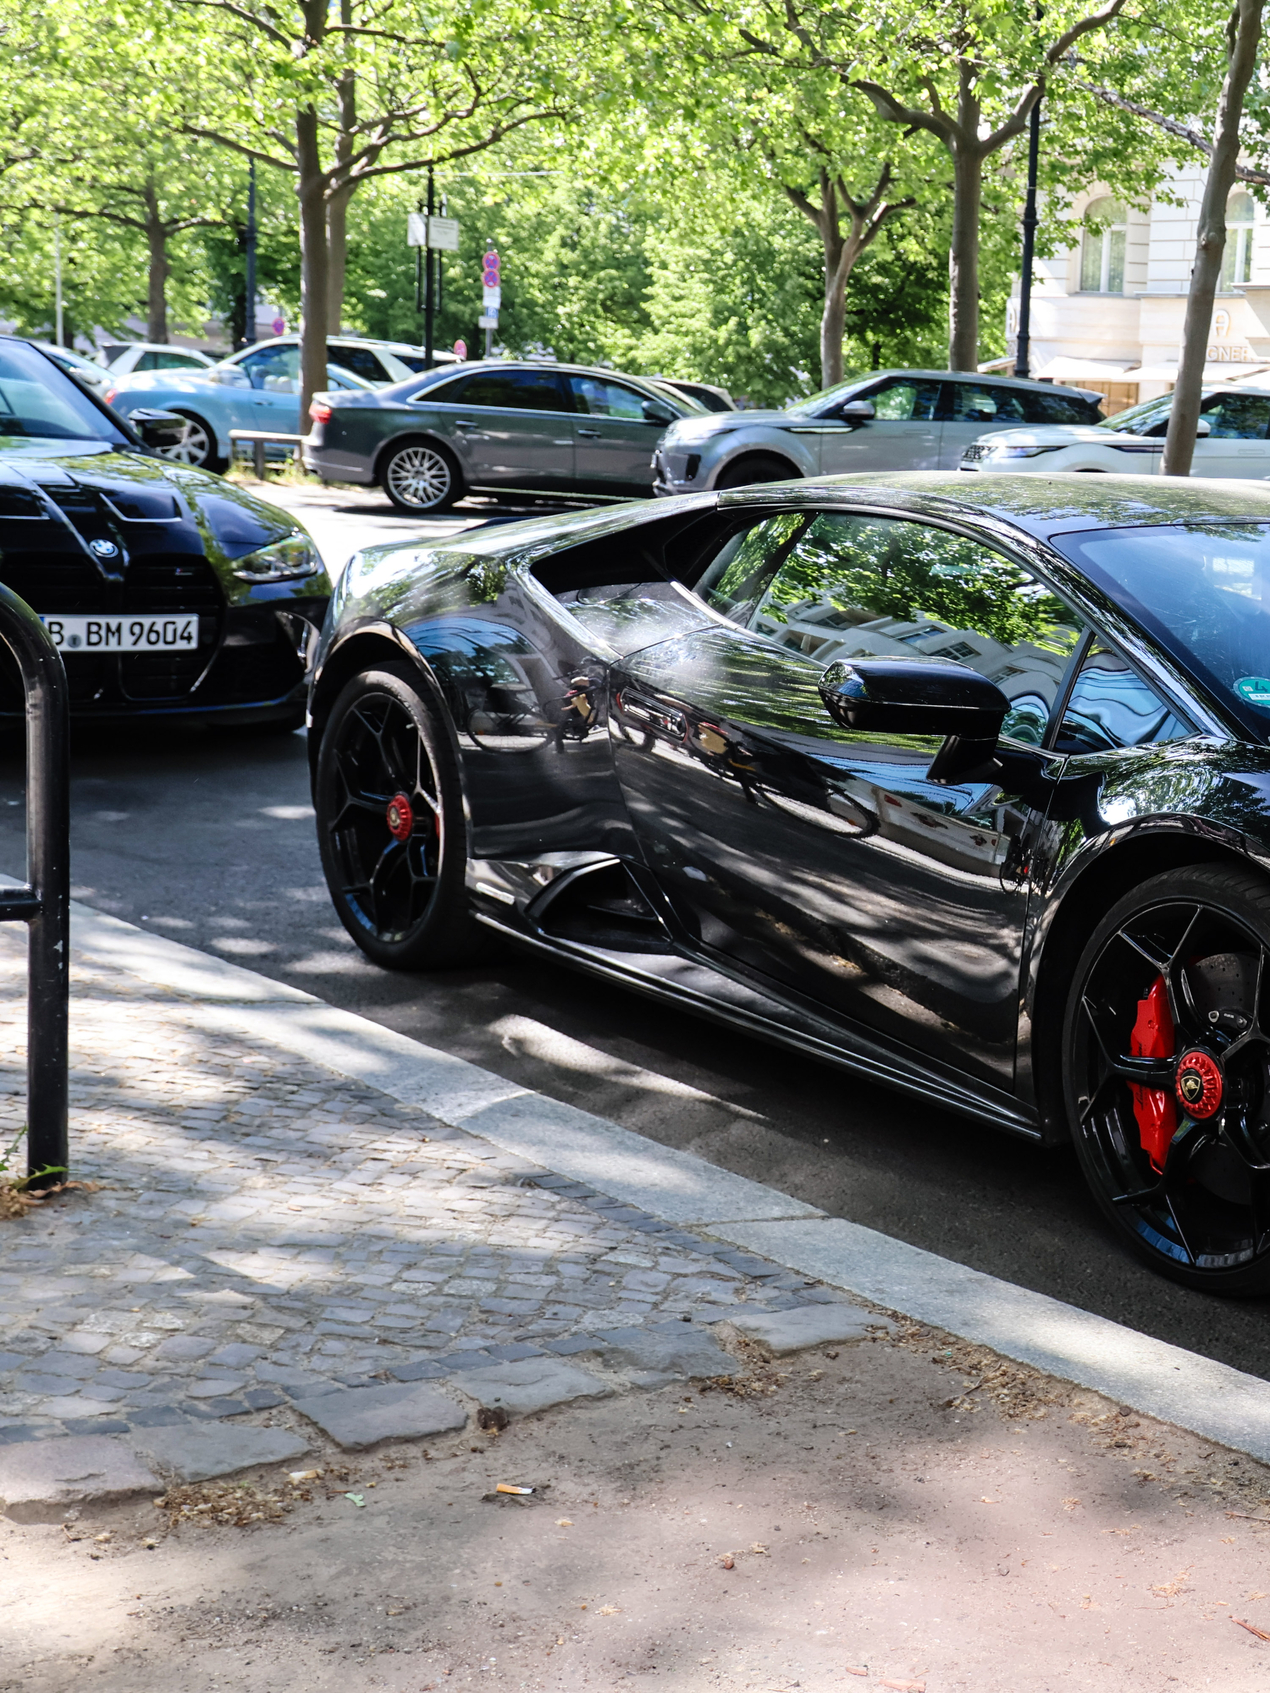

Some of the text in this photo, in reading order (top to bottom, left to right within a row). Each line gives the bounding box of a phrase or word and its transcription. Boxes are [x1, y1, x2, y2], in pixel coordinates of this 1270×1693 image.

[1206, 346, 1253, 362] GNER
[49, 621, 193, 646] B BM 9604
[1255, 681, 1268, 692] 4
